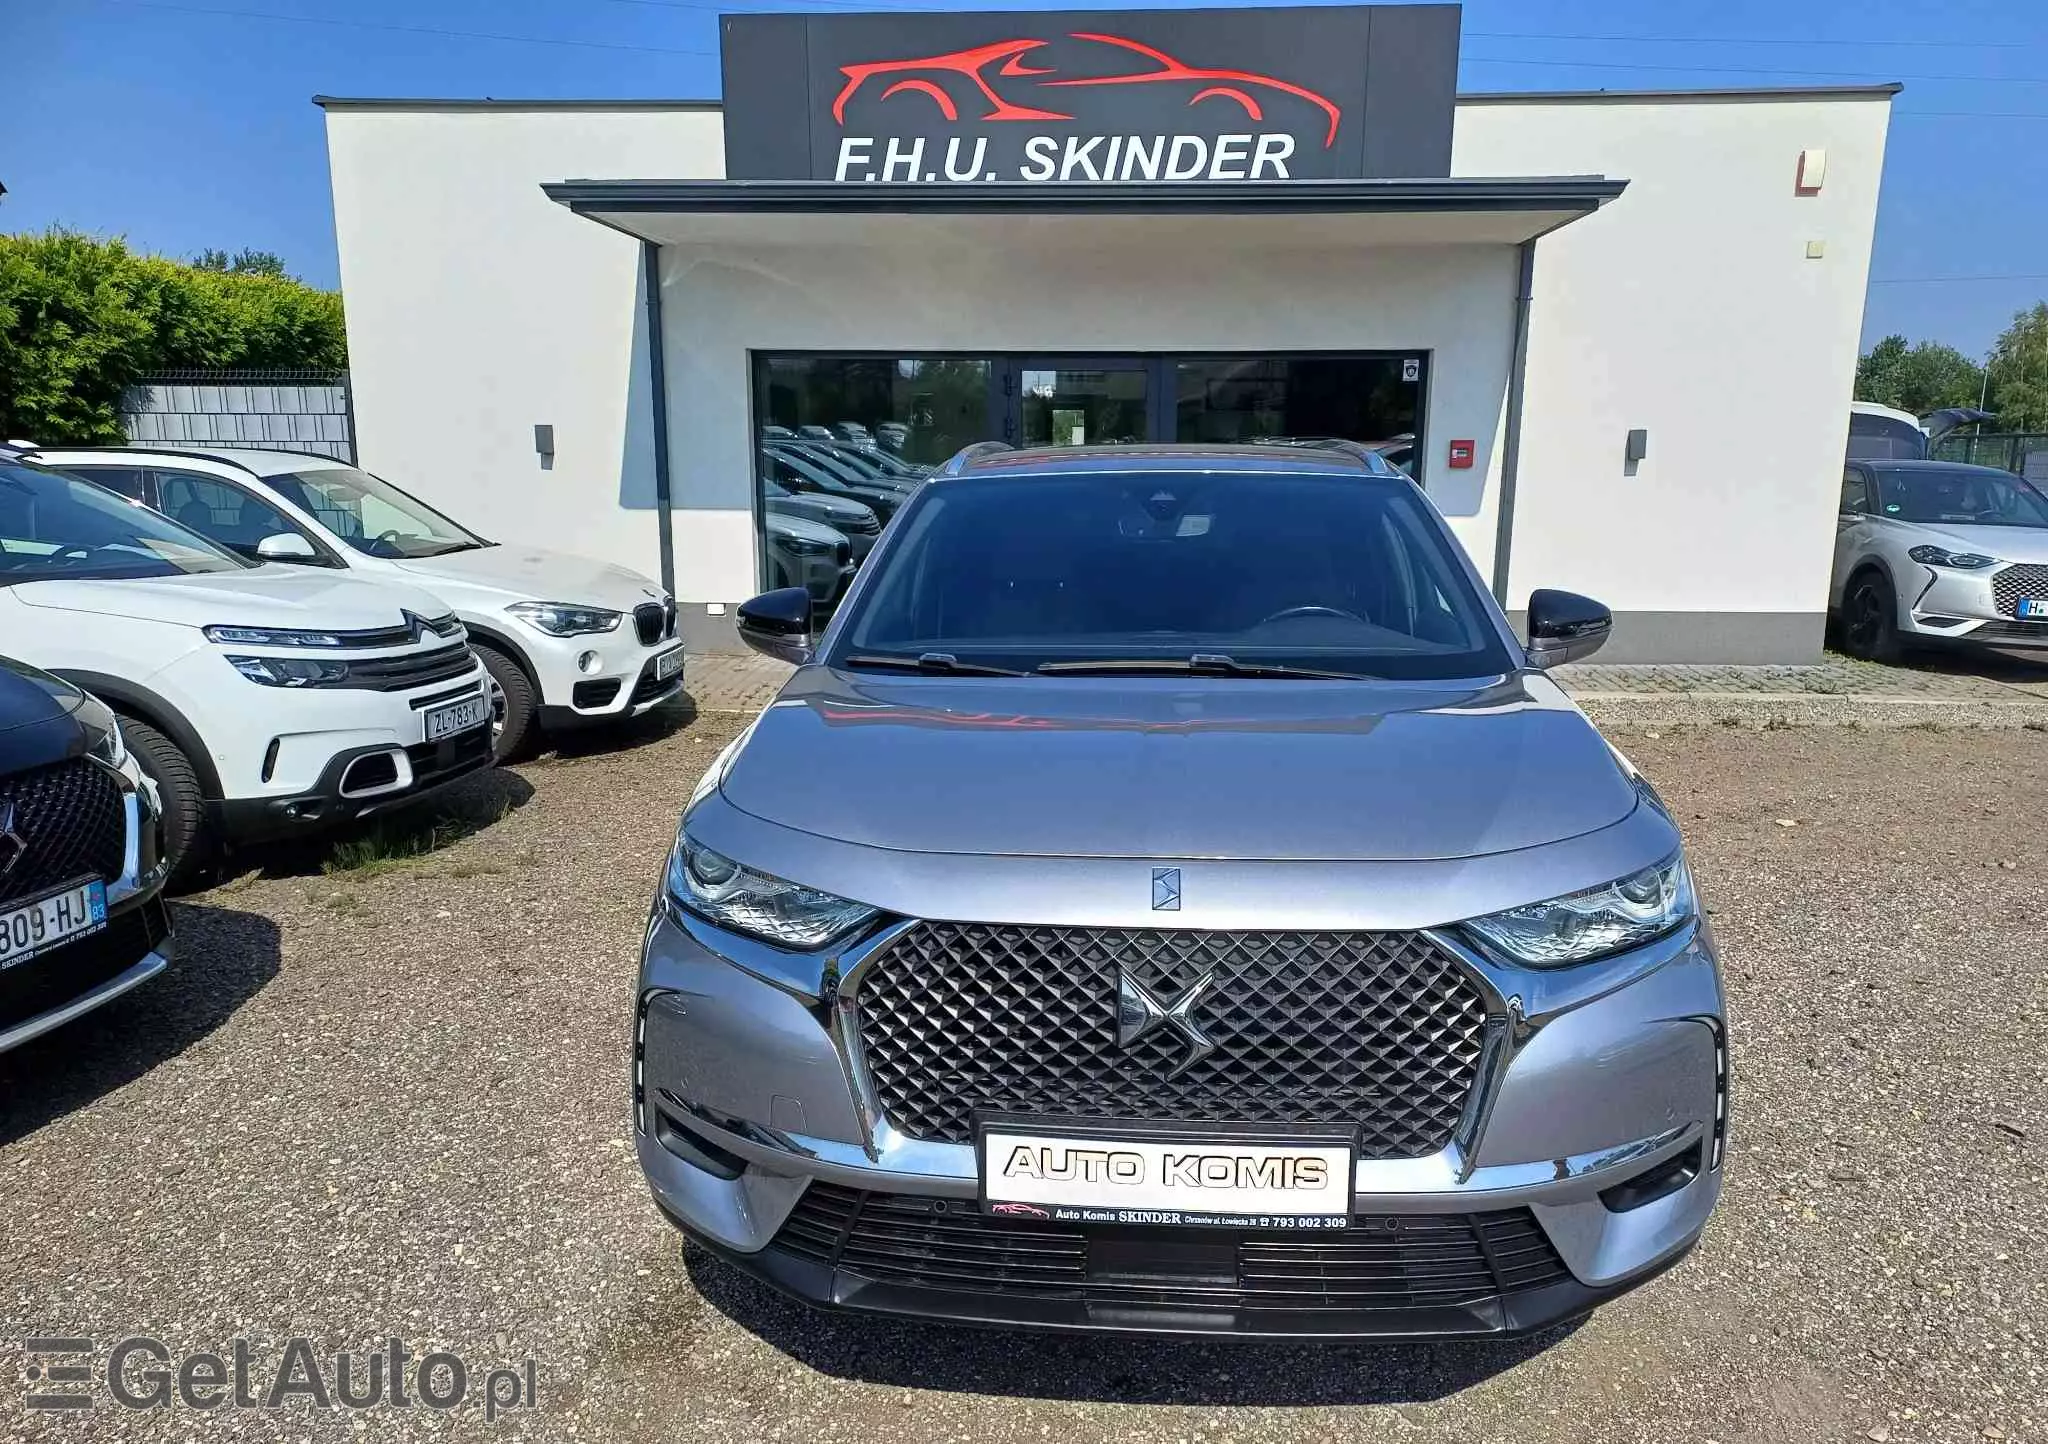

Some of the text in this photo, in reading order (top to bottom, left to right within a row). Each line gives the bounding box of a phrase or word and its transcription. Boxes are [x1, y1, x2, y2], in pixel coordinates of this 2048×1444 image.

[834, 133, 1297, 182] F.H.U. SKINDER
[92, 904, 106, 921] 83
[1003, 1146, 1329, 1190] AUTO KOMIS
[1055, 1208, 1081, 1220] Auto
[1082, 1210, 1116, 1221] Komis
[1118, 1211, 1182, 1224] SKINDER
[1272, 1217, 1295, 1228] 793
[1298, 1217, 1321, 1228] 002
[1324, 1217, 1347, 1228] 309
